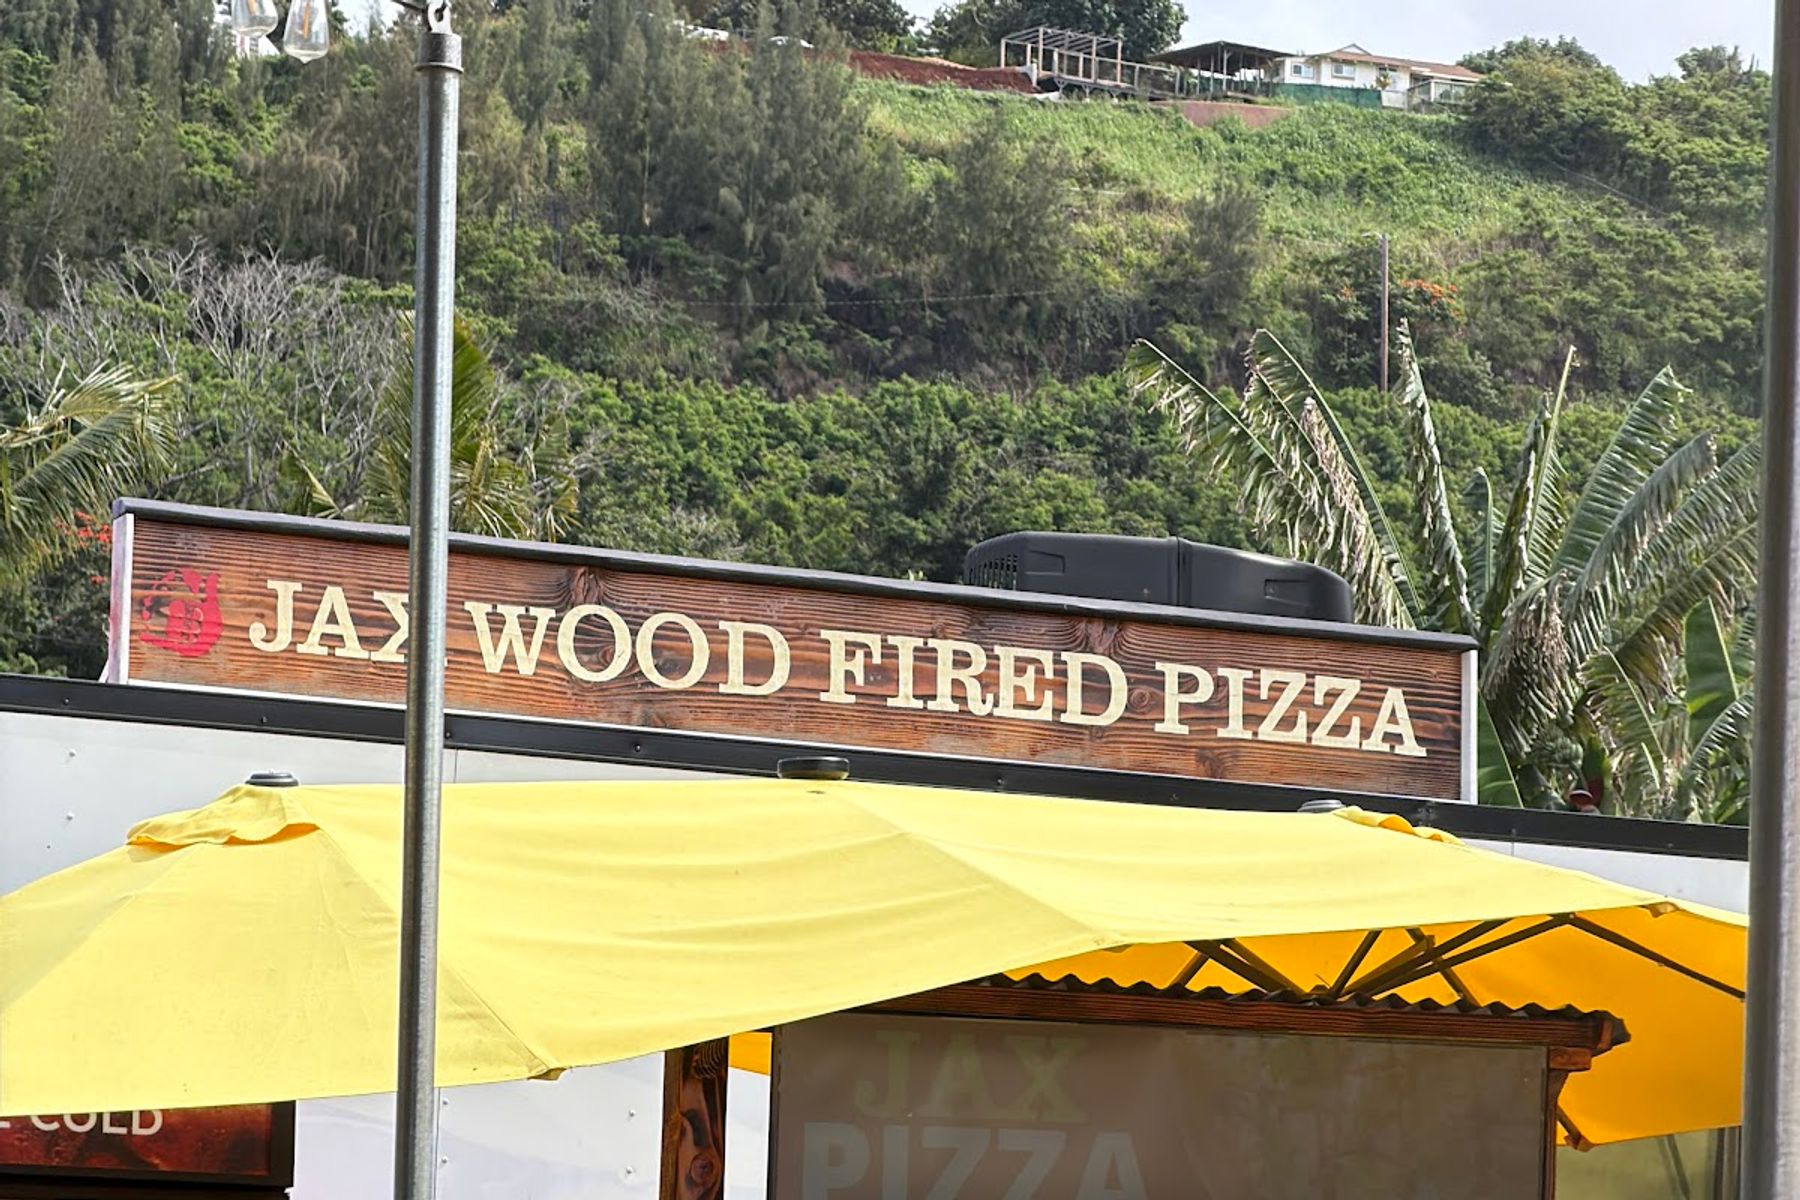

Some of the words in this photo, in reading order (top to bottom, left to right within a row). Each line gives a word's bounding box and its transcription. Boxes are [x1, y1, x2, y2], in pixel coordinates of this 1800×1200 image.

[464, 599, 790, 697] WOOD
[819, 628, 1128, 727] FIRED
[1153, 660, 1427, 758] PIZZA
[853, 1030, 1091, 1123] JAX
